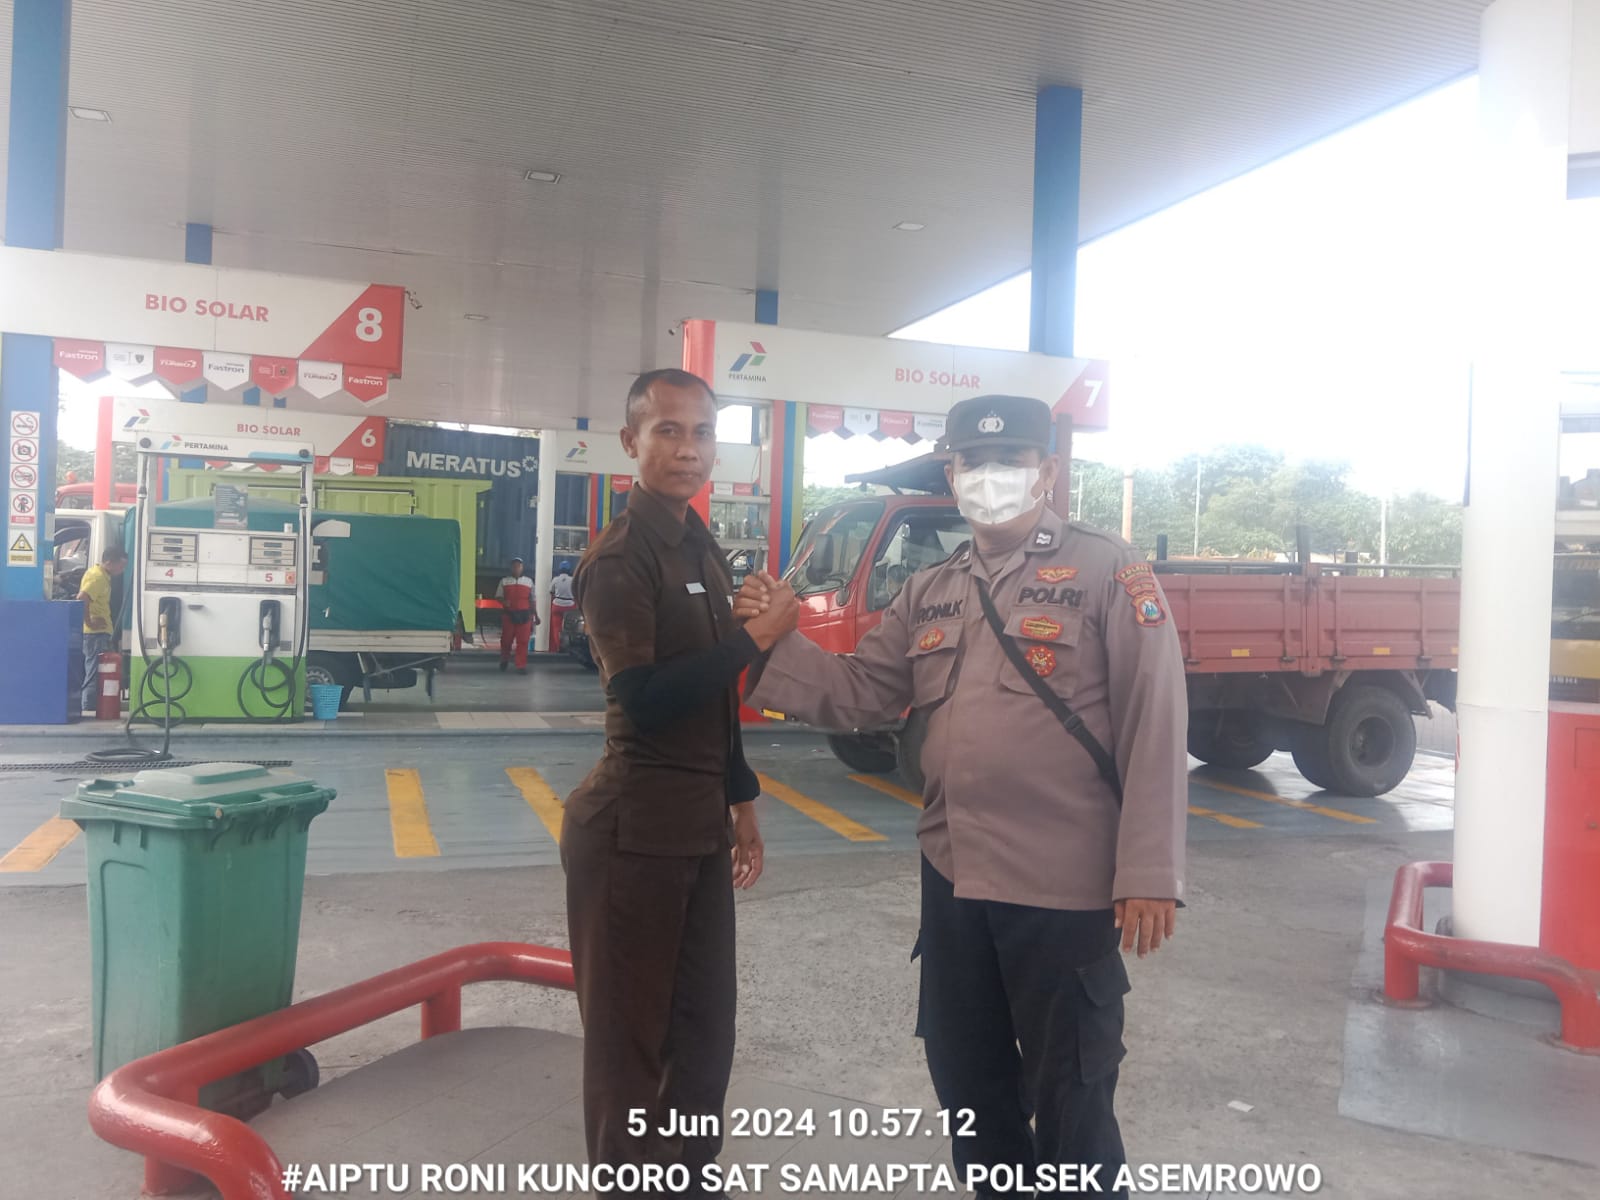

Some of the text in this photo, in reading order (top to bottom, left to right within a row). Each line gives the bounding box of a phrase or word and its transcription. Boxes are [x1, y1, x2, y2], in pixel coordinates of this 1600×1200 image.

[145, 293, 270, 322] BIO SOLAR
[355, 306, 383, 342] 8
[59, 350, 99, 361] Fastron
[208, 363, 245, 374] Fastron
[348, 376, 383, 386] Fastron
[728, 373, 767, 383] PERTAMINA
[895, 367, 981, 389] BIO SOLAR
[1084, 379, 1104, 408] 7
[236, 423, 301, 437] BIO SOLAR
[361, 429, 376, 448] 6
[184, 441, 230, 452] PERTAMINA
[406, 450, 522, 478] MERATUS
[164, 568, 175, 579] 4
[264, 572, 274, 583] 5
[1019, 586, 1084, 608] POLRI
